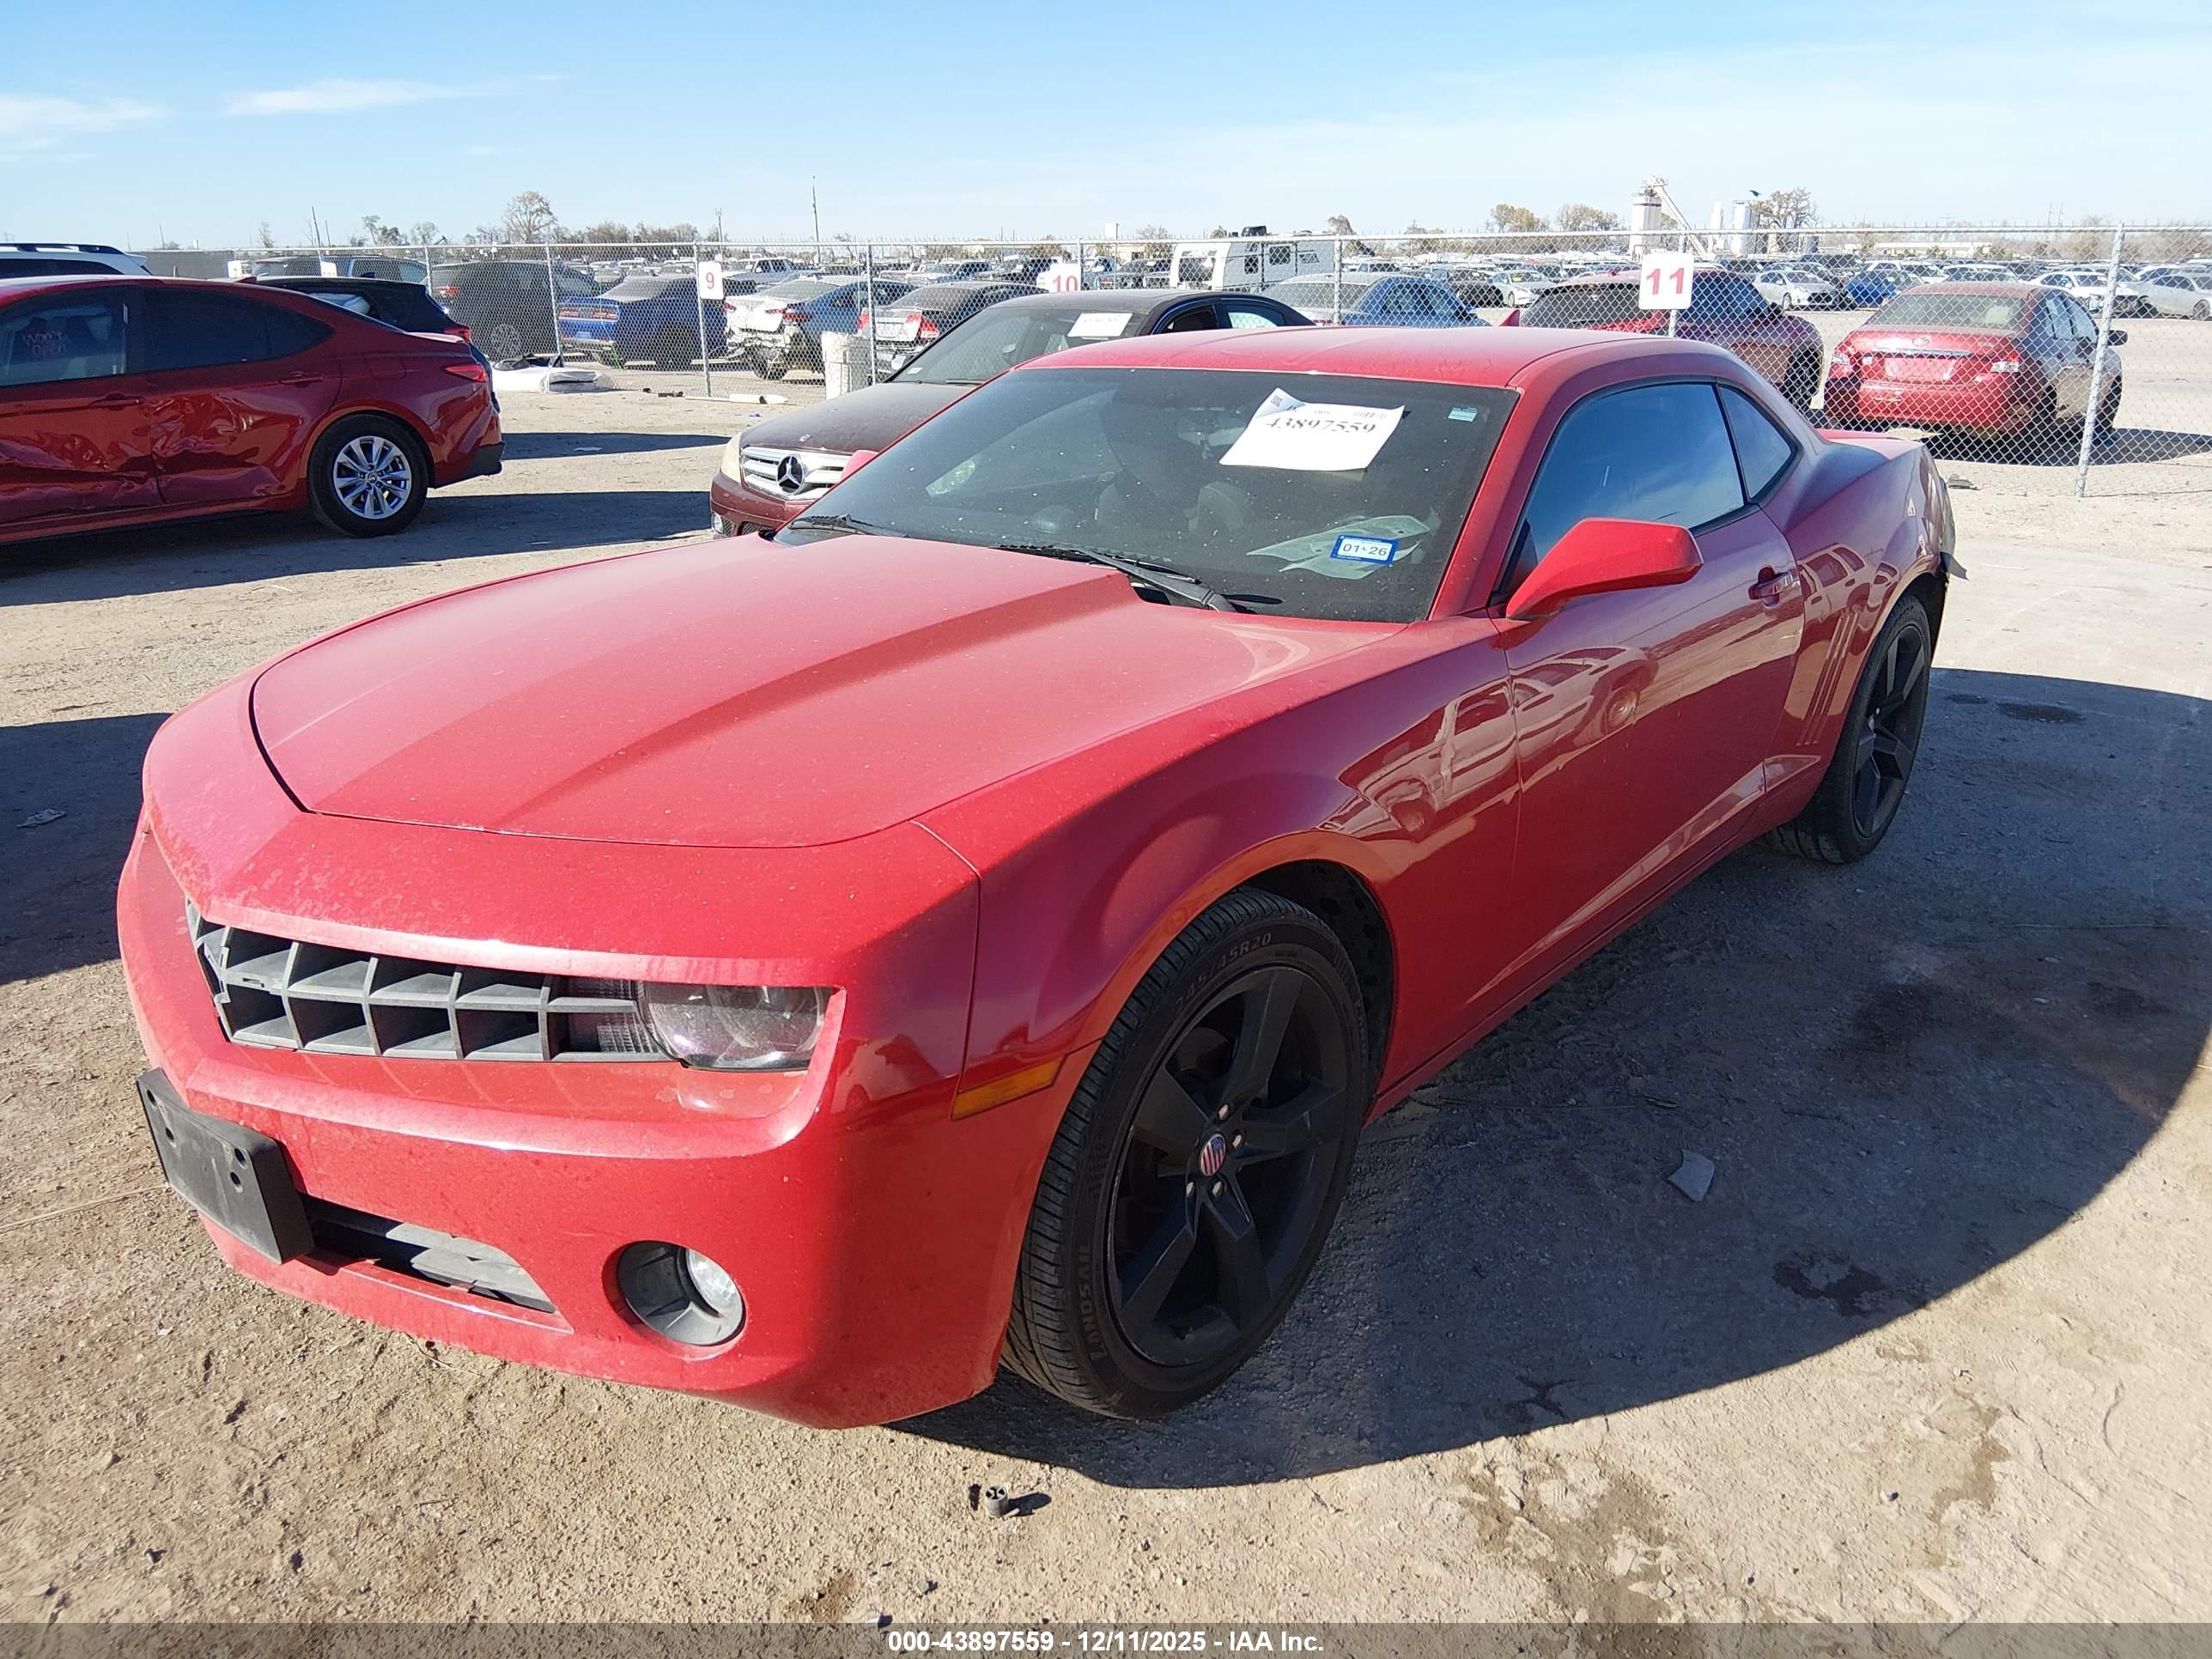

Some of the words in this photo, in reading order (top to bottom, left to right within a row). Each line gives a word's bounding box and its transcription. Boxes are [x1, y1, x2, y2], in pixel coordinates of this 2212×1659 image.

[706, 271, 715, 289] 9
[1052, 274, 1079, 294] 10
[1645, 267, 1685, 295] 11
[1266, 416, 1376, 434] 43897559
